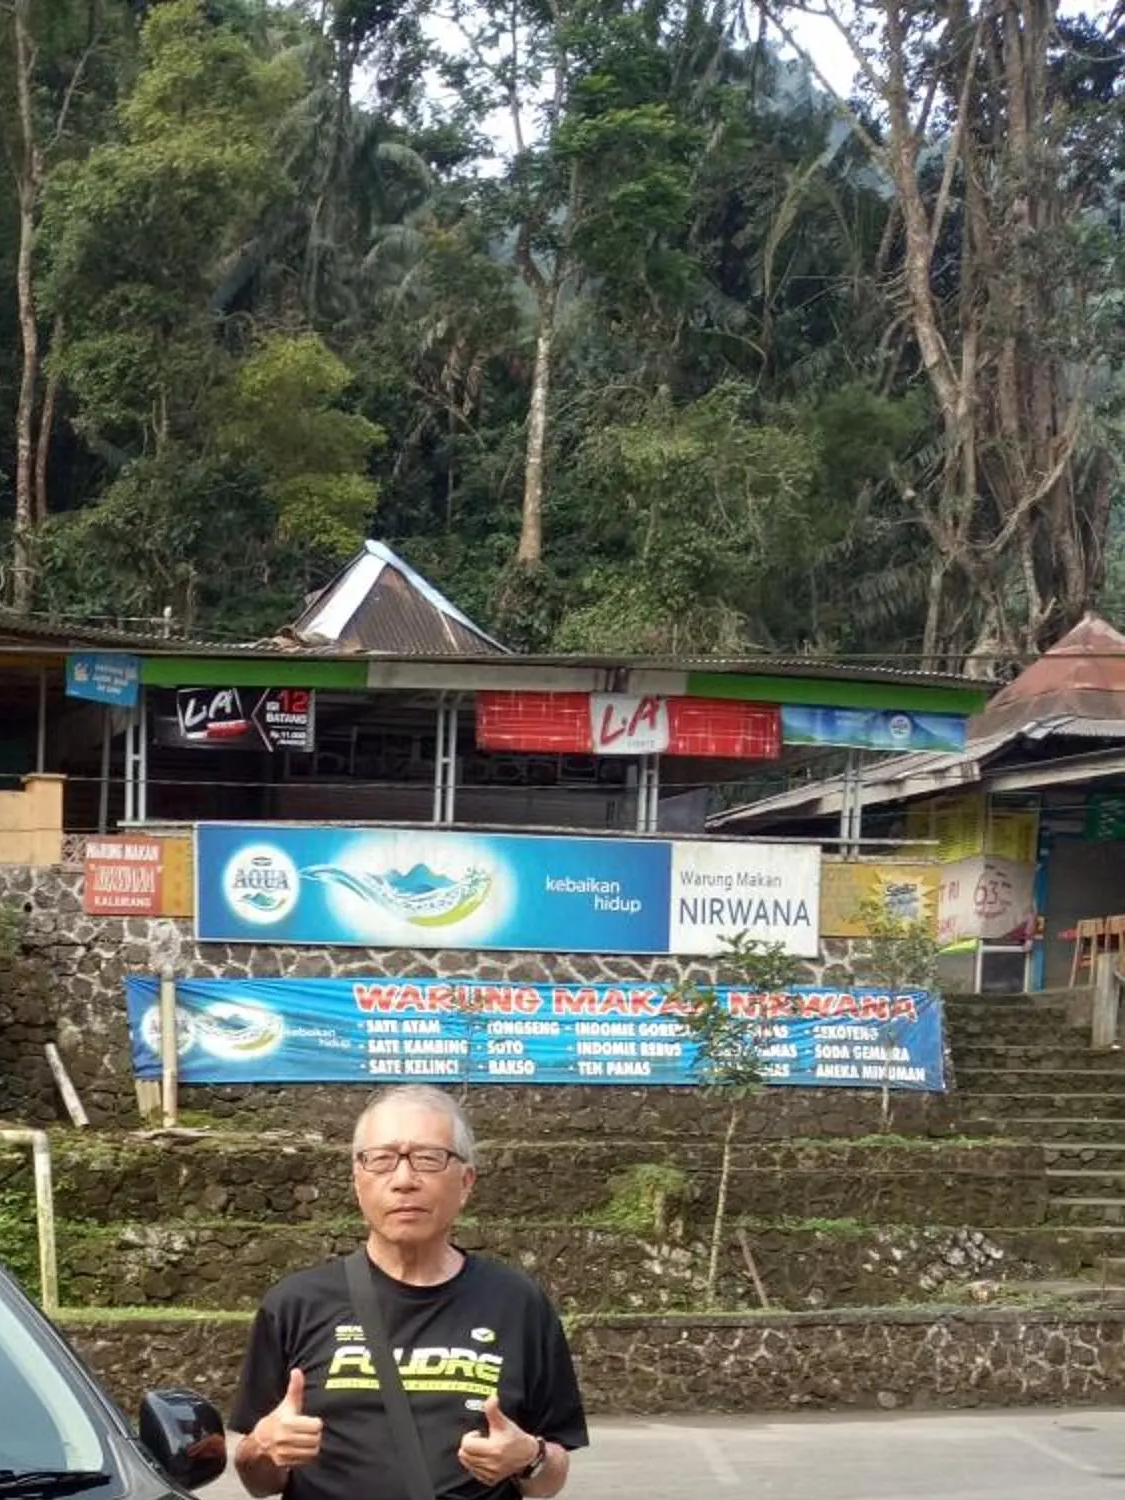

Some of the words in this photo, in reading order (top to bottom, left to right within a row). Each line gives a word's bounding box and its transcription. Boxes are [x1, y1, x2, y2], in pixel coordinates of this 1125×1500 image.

[278, 689, 309, 713] 12
[266, 712, 307, 725] BATANG
[232, 868, 292, 893] AQUA
[545, 875, 620, 893] kebaikan
[680, 871, 733, 890] Warung
[736, 872, 782, 889] Makan
[594, 896, 643, 914] hidup
[678, 898, 812, 927] NIRWANA
[353, 983, 542, 1015] WARUNG
[366, 1019, 399, 1034] SATE
[401, 1019, 441, 1034] AYAM
[486, 1021, 561, 1036] TONGSENG
[574, 1022, 636, 1037] INDOMIE
[638, 1023, 697, 1038] GORE
[367, 1039, 400, 1054] SATE
[403, 1039, 469, 1055] KAMBING
[487, 1039, 524, 1055] SOTO
[576, 1041, 637, 1056] INDOMIE
[639, 1042, 683, 1057] REBUS
[815, 1044, 851, 1059] SODA
[369, 1059, 402, 1075] SATE
[403, 1060, 460, 1075] KELINCI
[487, 1060, 536, 1076] BAKSO
[577, 1061, 604, 1076] TEH
[606, 1061, 652, 1076] PANAS
[815, 1063, 860, 1079] ANEKA
